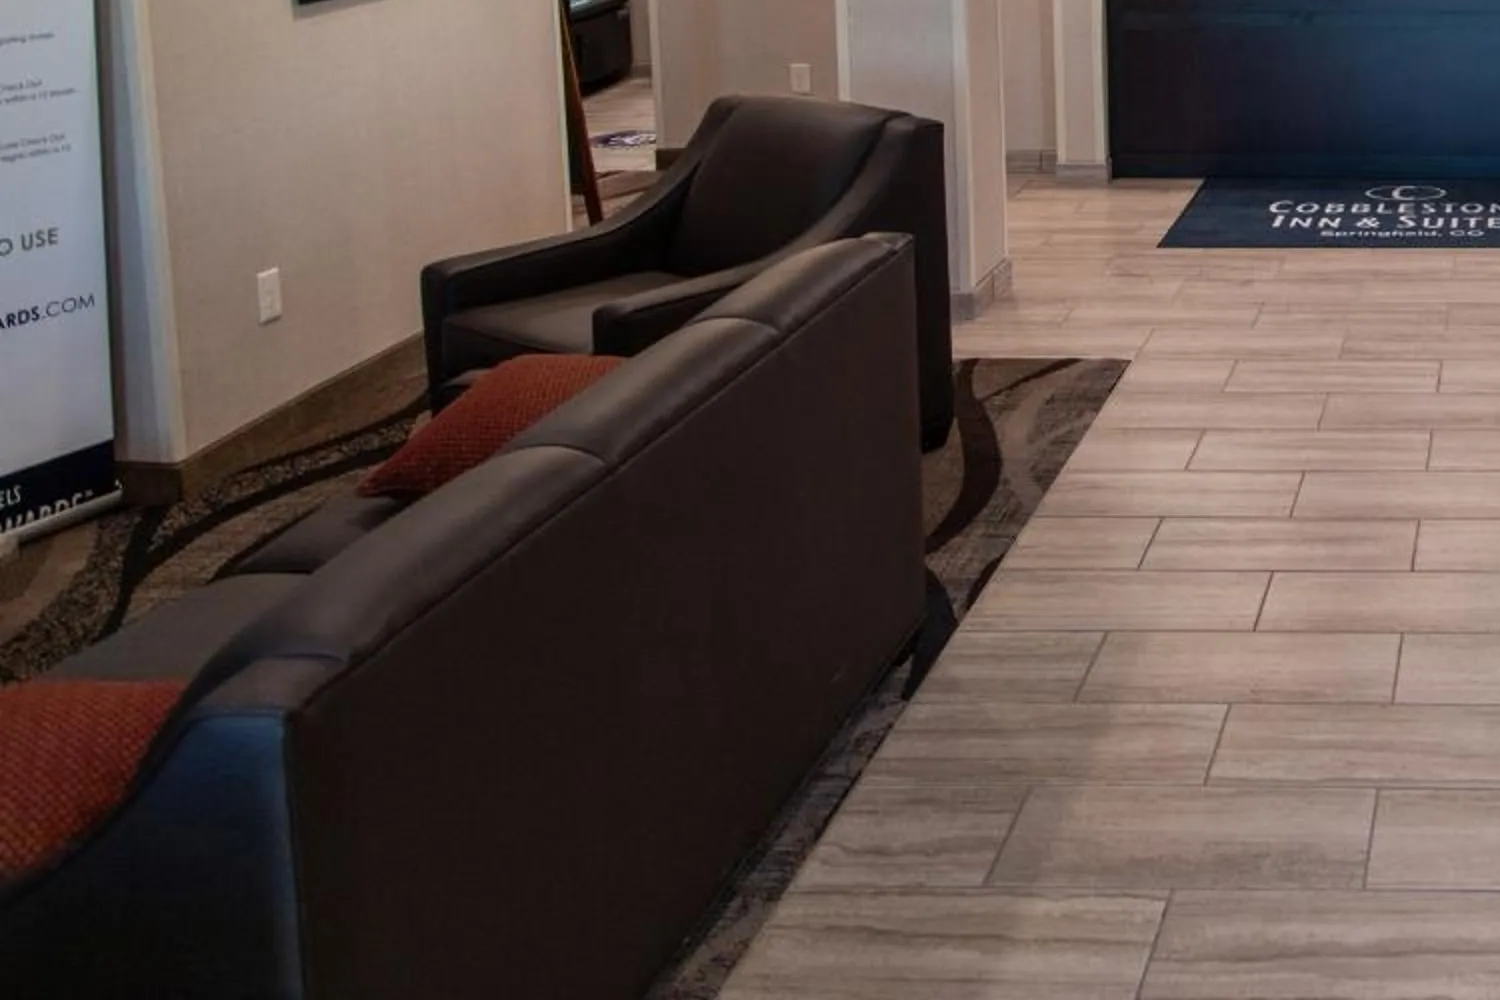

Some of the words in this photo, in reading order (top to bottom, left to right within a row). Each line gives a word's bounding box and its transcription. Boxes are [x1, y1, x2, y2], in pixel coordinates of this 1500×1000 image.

[1271, 215, 1342, 229] INN
[1355, 216, 1380, 229] &
[21, 227, 59, 252] USE
[1449, 229, 1485, 237] CO
